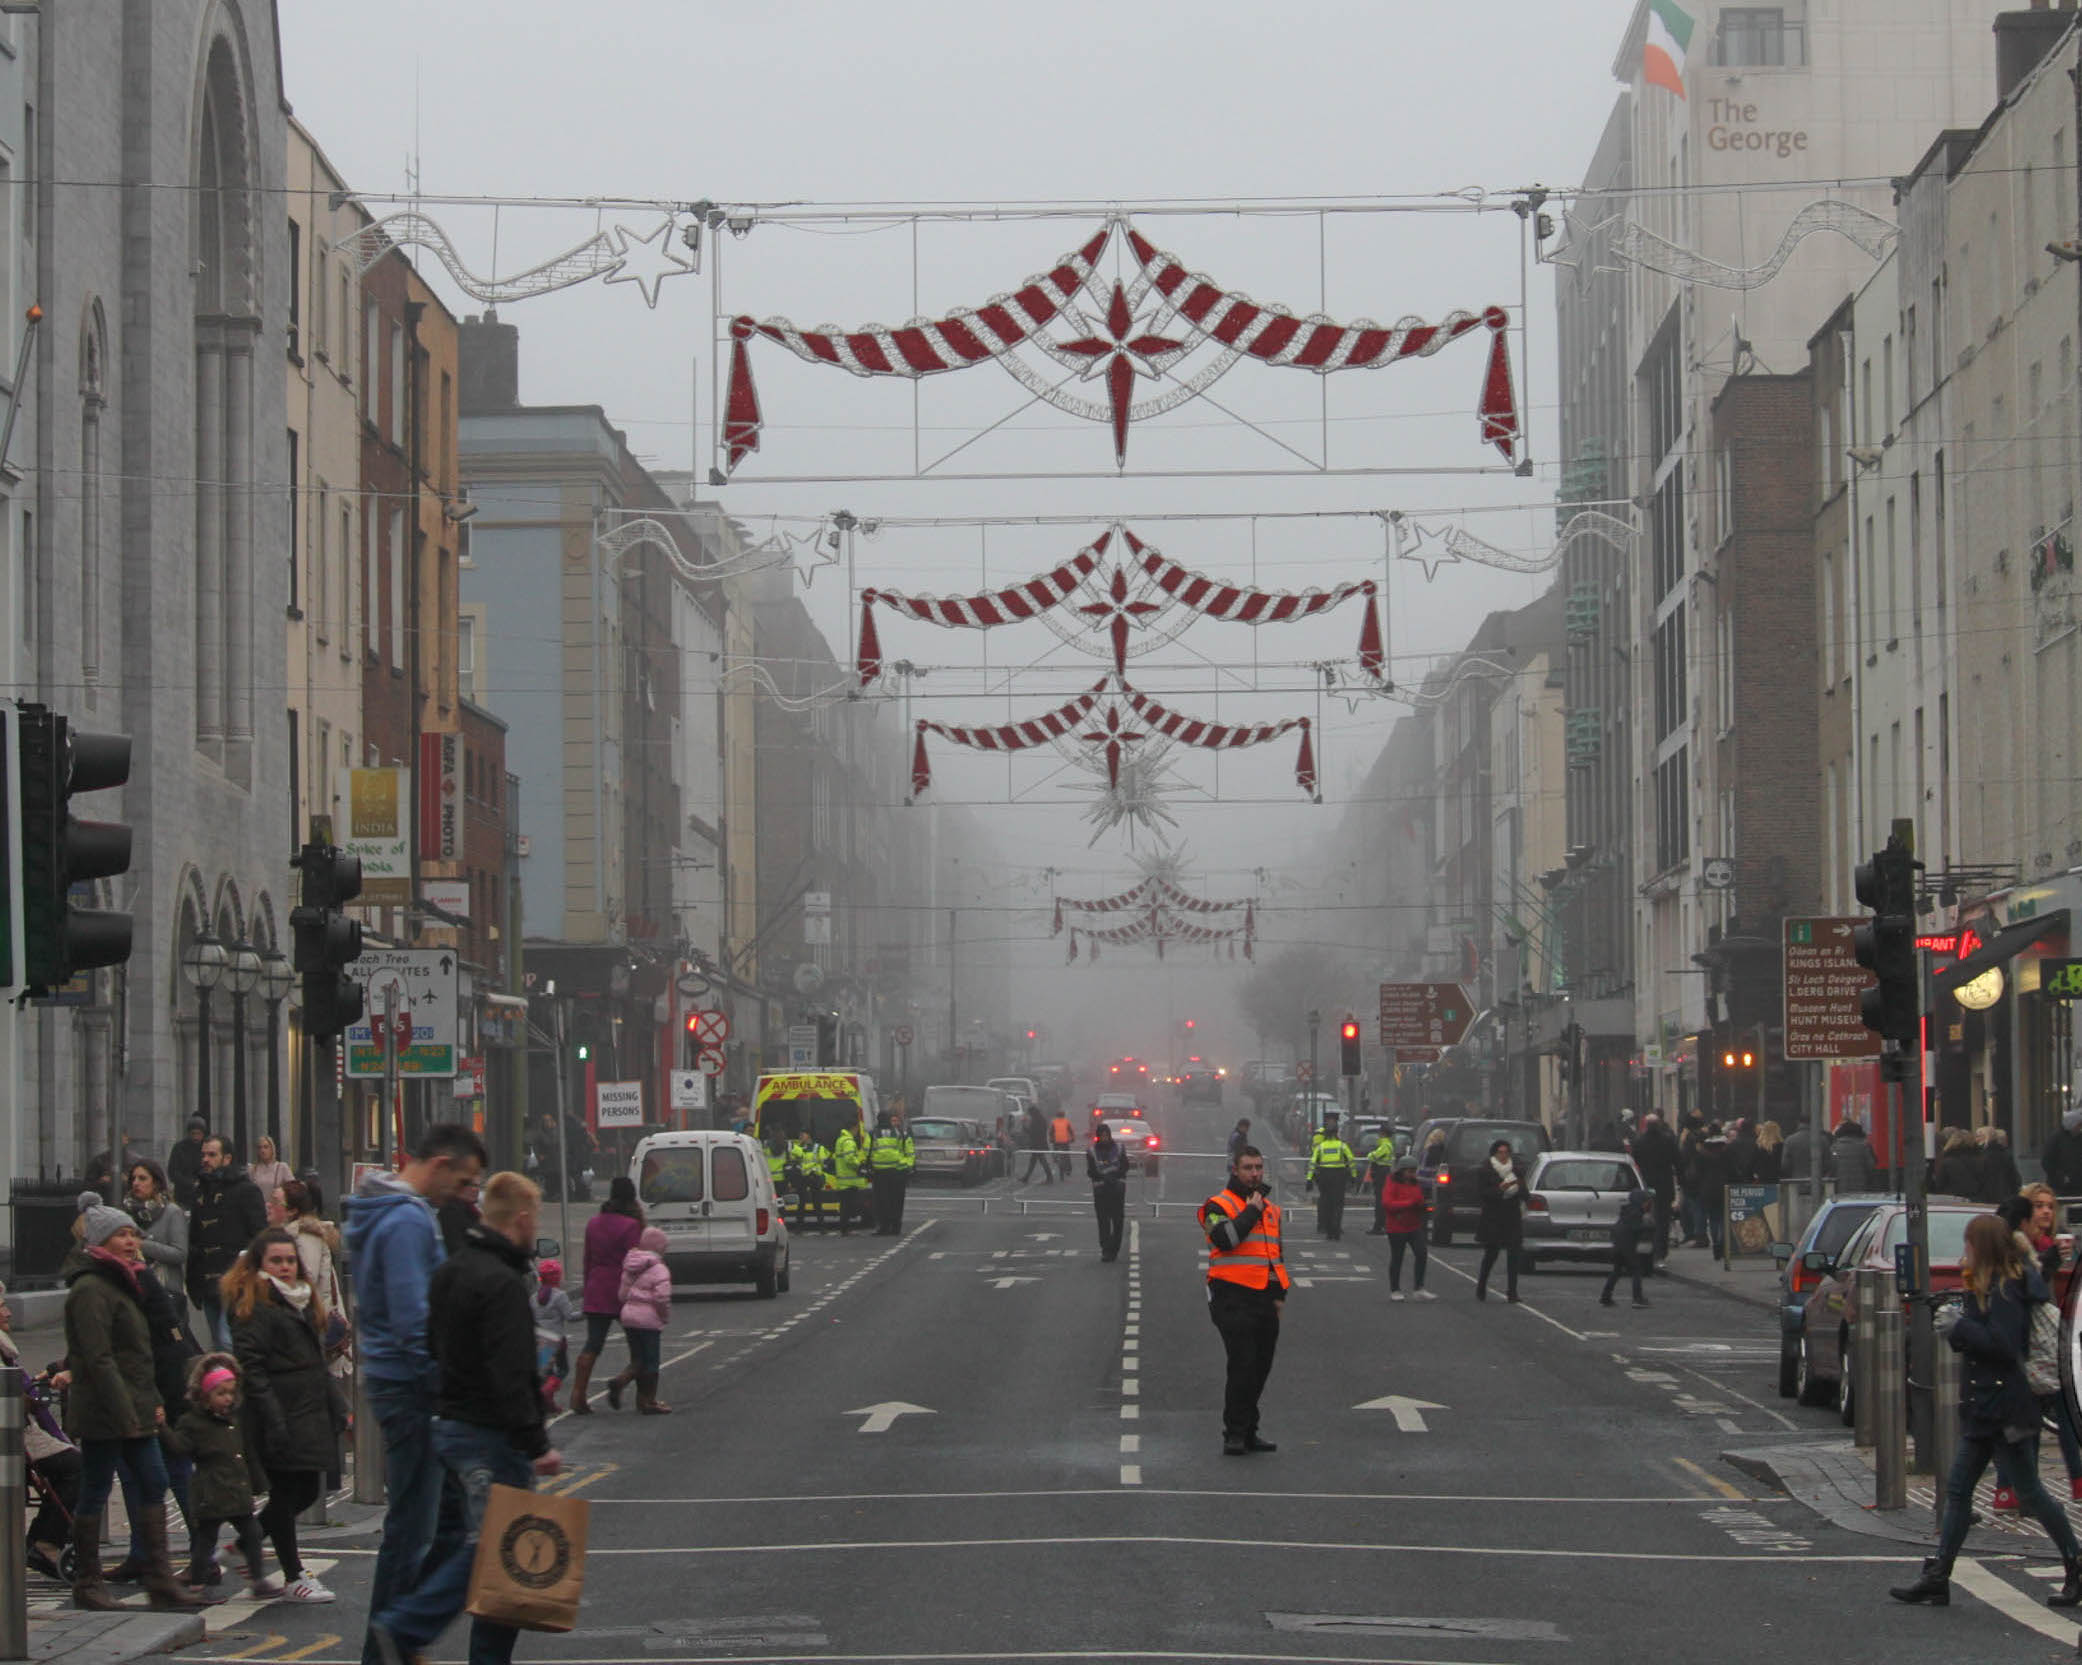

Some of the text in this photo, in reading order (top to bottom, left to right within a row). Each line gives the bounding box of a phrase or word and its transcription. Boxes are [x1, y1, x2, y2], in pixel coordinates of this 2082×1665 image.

[1707, 97, 1757, 123] The
[1707, 126, 1808, 158] George
[442, 735, 455, 775] AGFA
[355, 822, 395, 833] INDIA
[442, 803, 455, 857] PHOTO
[1790, 958, 1821, 968] KINGS
[1827, 986, 1857, 996] DRIVE
[1830, 1003, 1853, 1013] Hunt
[1790, 1015, 1818, 1025] HUNT
[1790, 1044, 1841, 1054] CITY HALL
[773, 1079, 848, 1090] AMBULANCE
[601, 1090, 639, 1101] MISSING
[601, 1105, 640, 1117] PERSONS
